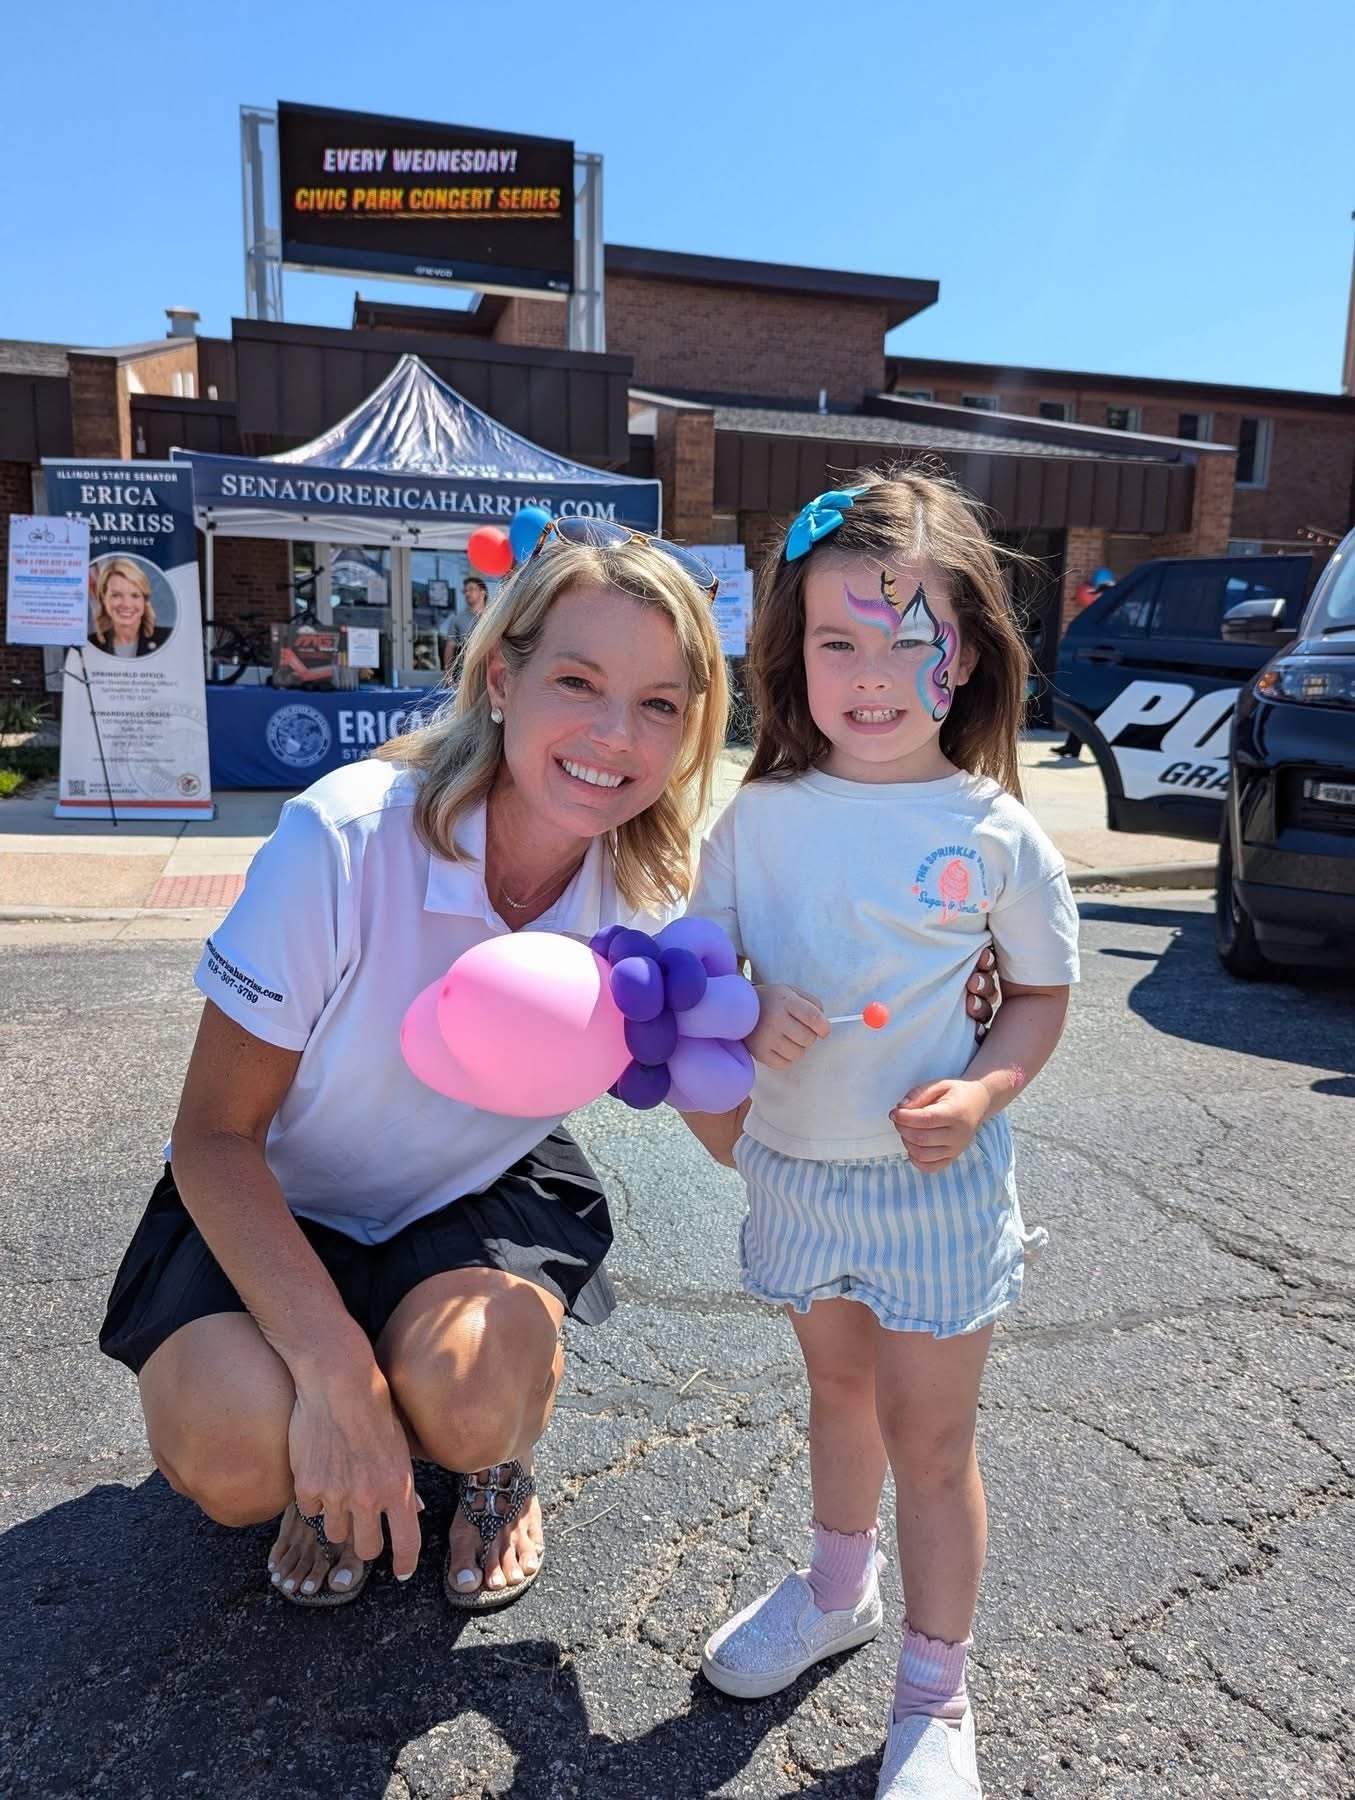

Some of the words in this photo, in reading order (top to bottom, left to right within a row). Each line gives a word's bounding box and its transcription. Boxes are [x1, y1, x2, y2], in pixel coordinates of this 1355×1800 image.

[323, 148, 386, 172] EVERY
[393, 148, 517, 173] WEDNESDAY!
[295, 187, 347, 211] CIVIC
[352, 187, 403, 211] PARK
[408, 187, 493, 210] CONCERT
[497, 187, 561, 210] SERIES
[56, 469, 100, 480] ILLINOIS
[102, 470, 131, 481] STATE
[133, 471, 178, 483] SENATOR
[80, 484, 159, 506] ERICA
[110, 536, 155, 546] DISTRICT
[916, 863, 930, 883] THE
[925, 845, 977, 865] SPRINKLE
[207, 957, 259, 1004] 618-307-5789
